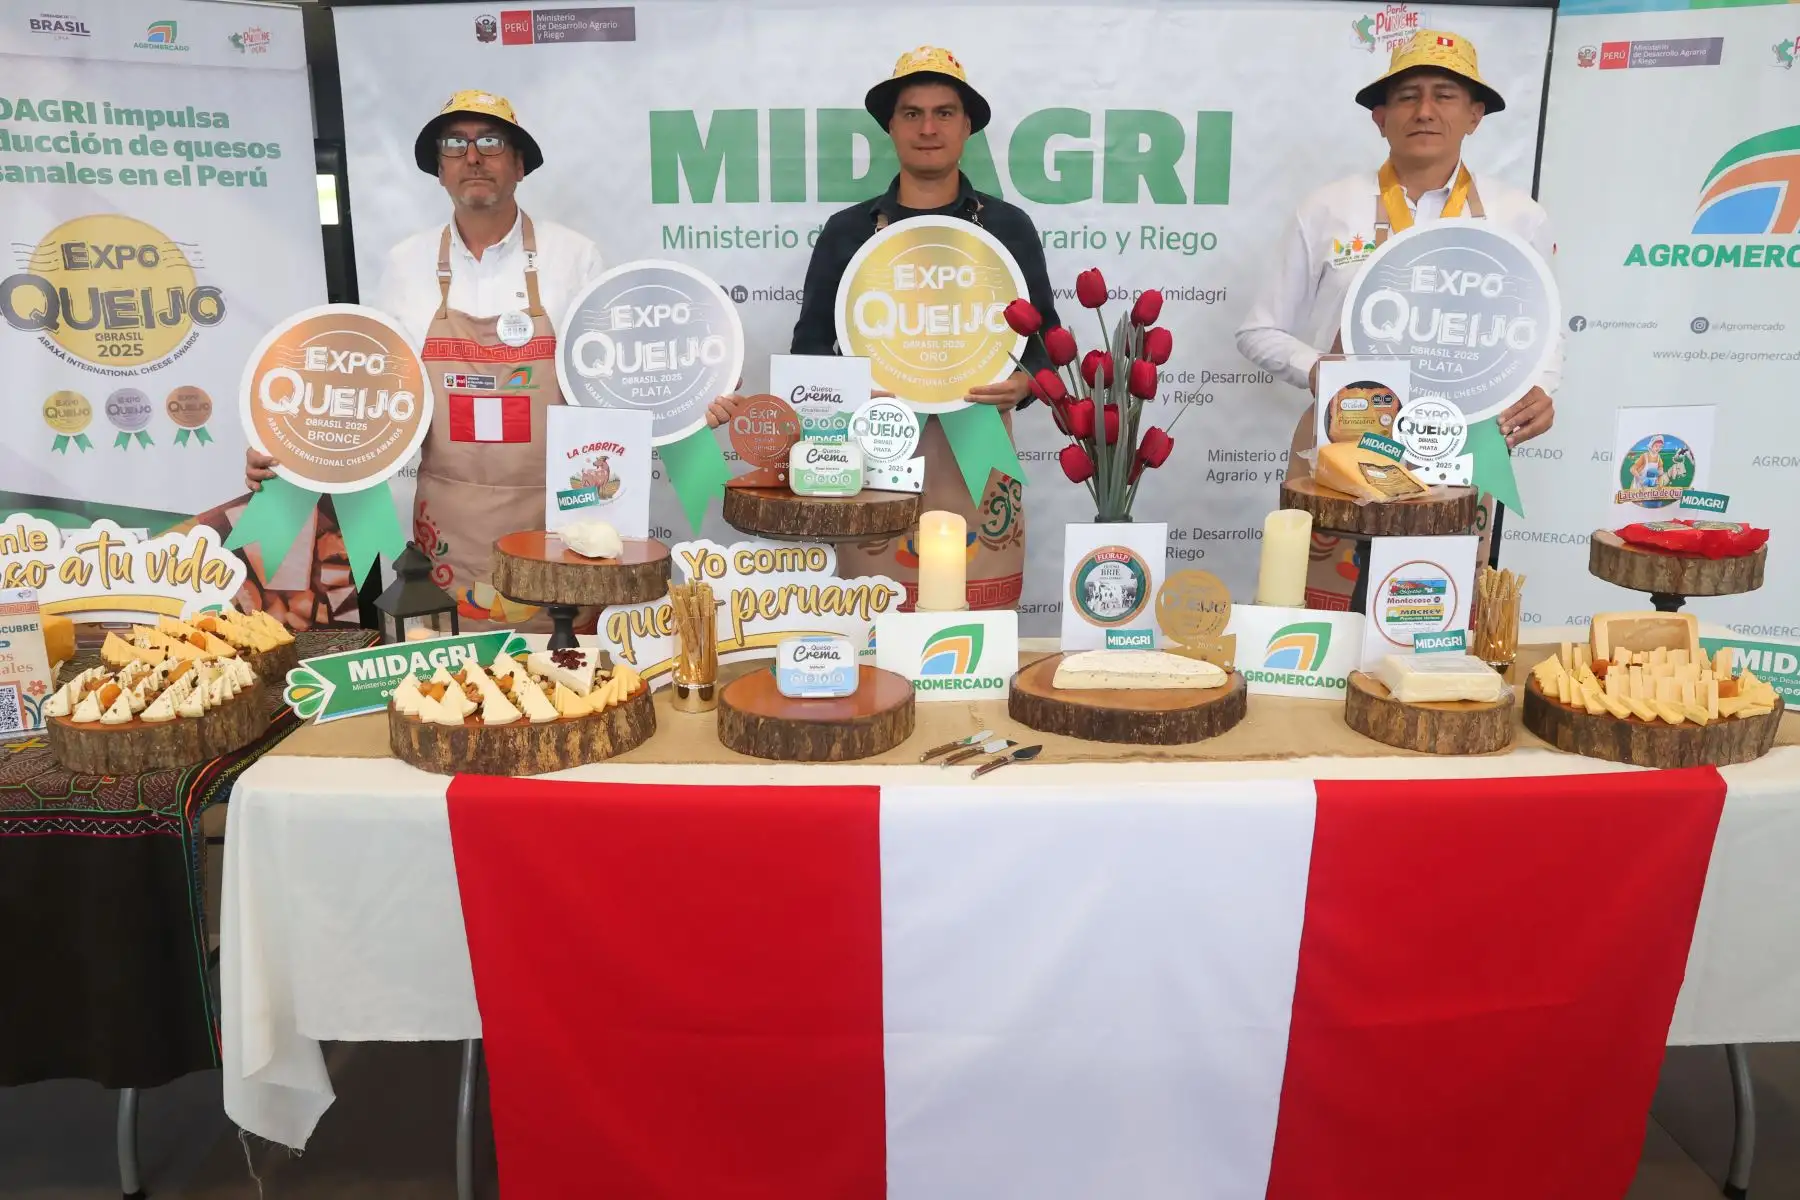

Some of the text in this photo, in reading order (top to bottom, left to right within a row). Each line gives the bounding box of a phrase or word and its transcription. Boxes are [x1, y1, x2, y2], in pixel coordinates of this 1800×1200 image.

[536, 13, 575, 22] Ministerio
[30, 19, 90, 33] BRASIL
[505, 20, 528, 32] PERÚ
[537, 21, 618, 31] de Desarrollo Agrario
[544, 32, 564, 40] Riego
[1603, 50, 1625, 60] PERÚ
[1680, 49, 1706, 57] Agrario
[104, 102, 230, 131] impulsa
[128, 134, 168, 156] de
[174, 140, 282, 162] quesos
[649, 107, 1232, 206] MIDGRI
[0, 162, 268, 188] anales en el Perú
[662, 225, 798, 249] Ministerio
[1042, 225, 1106, 250] rario
[1116, 231, 1131, 254] y
[1140, 226, 1218, 255] Riego
[61, 241, 160, 271] EXPO
[1623, 243, 1800, 268] AGROMERC
[894, 264, 976, 291] EXPO
[1411, 265, 1504, 298] EXPO
[752, 286, 804, 304] midag
[0, 273, 227, 334] QUEIJO
[610, 302, 691, 330] EXPO
[853, 290, 1011, 340] QUEIJO
[1360, 289, 1538, 350] QUEIJO
[37, 331, 200, 376] ARAXÁ INTERNATIONAL CHEESE AWARDS
[98, 344, 144, 358] 2025
[572, 331, 726, 379] QUEIJO
[920, 352, 948, 362] ORO
[1454, 350, 1480, 360] 2025
[304, 346, 386, 376] EXPO
[1419, 359, 1464, 374] PLATA
[661, 374, 682, 382] 2025
[1178, 371, 1195, 384] de
[1201, 370, 1274, 384] Desarrollo
[259, 367, 415, 422] QUEIJO
[632, 386, 672, 398] PLATA
[791, 386, 844, 404] Crema
[1162, 390, 1214, 406] y Riego
[1409, 384, 1452, 400] ATIONAL
[1454, 384, 1488, 399] CHEESE
[45, 408, 90, 419] QUEIJO
[108, 404, 152, 416] QUEIJO
[667, 399, 694, 418] CHEESE
[870, 410, 902, 422] EXPO
[346, 422, 368, 430] 2025
[734, 416, 796, 435] QUEI
[853, 416, 915, 438] QUEIJO
[1398, 416, 1464, 436] QUEIJO
[308, 430, 360, 444] BRONCE
[284, 440, 344, 466] INTERNATIONAL
[346, 452, 376, 466] CHEESE
[376, 428, 404, 456] AWARDS
[567, 442, 626, 460] LA CABRITA
[1360, 436, 1402, 458] MIDAGRI
[1510, 447, 1563, 460] ERCADO
[806, 448, 848, 464] Crema
[1017, 449, 1060, 461] esarro
[1208, 449, 1276, 462] Ministerio
[398, 466, 416, 478] Rie
[1206, 469, 1258, 484] Agrario
[1264, 472, 1272, 483] y
[558, 492, 595, 506] MIDAGRI
[1620, 492, 1627, 500] La
[1628, 490, 1658, 499] Lecherita
[1670, 489, 1682, 497] Qui
[1682, 495, 1724, 510] MIDAGRI
[1170, 528, 1263, 540] de Desarrollo
[1500, 530, 1590, 544] GROMERCAD
[58, 556, 94, 586] a
[76, 530, 134, 590] tu
[146, 537, 235, 593] vida
[1098, 552, 1128, 560] FLORALP
[1166, 547, 1205, 562] Riego
[680, 546, 827, 580] Yo como
[731, 583, 898, 646] peruano
[1108, 635, 1150, 646] MIDAGRI
[1416, 636, 1462, 649] MIDAGRI
[793, 646, 841, 662] Crema
[1732, 648, 1800, 674] MID
[0, 662, 34, 676] ales
[348, 643, 478, 682] MIDAGRI
[352, 681, 386, 691] Ministerio
[912, 677, 1004, 691] ROMERCADO
[1239, 670, 1346, 689] GROMERCADO
